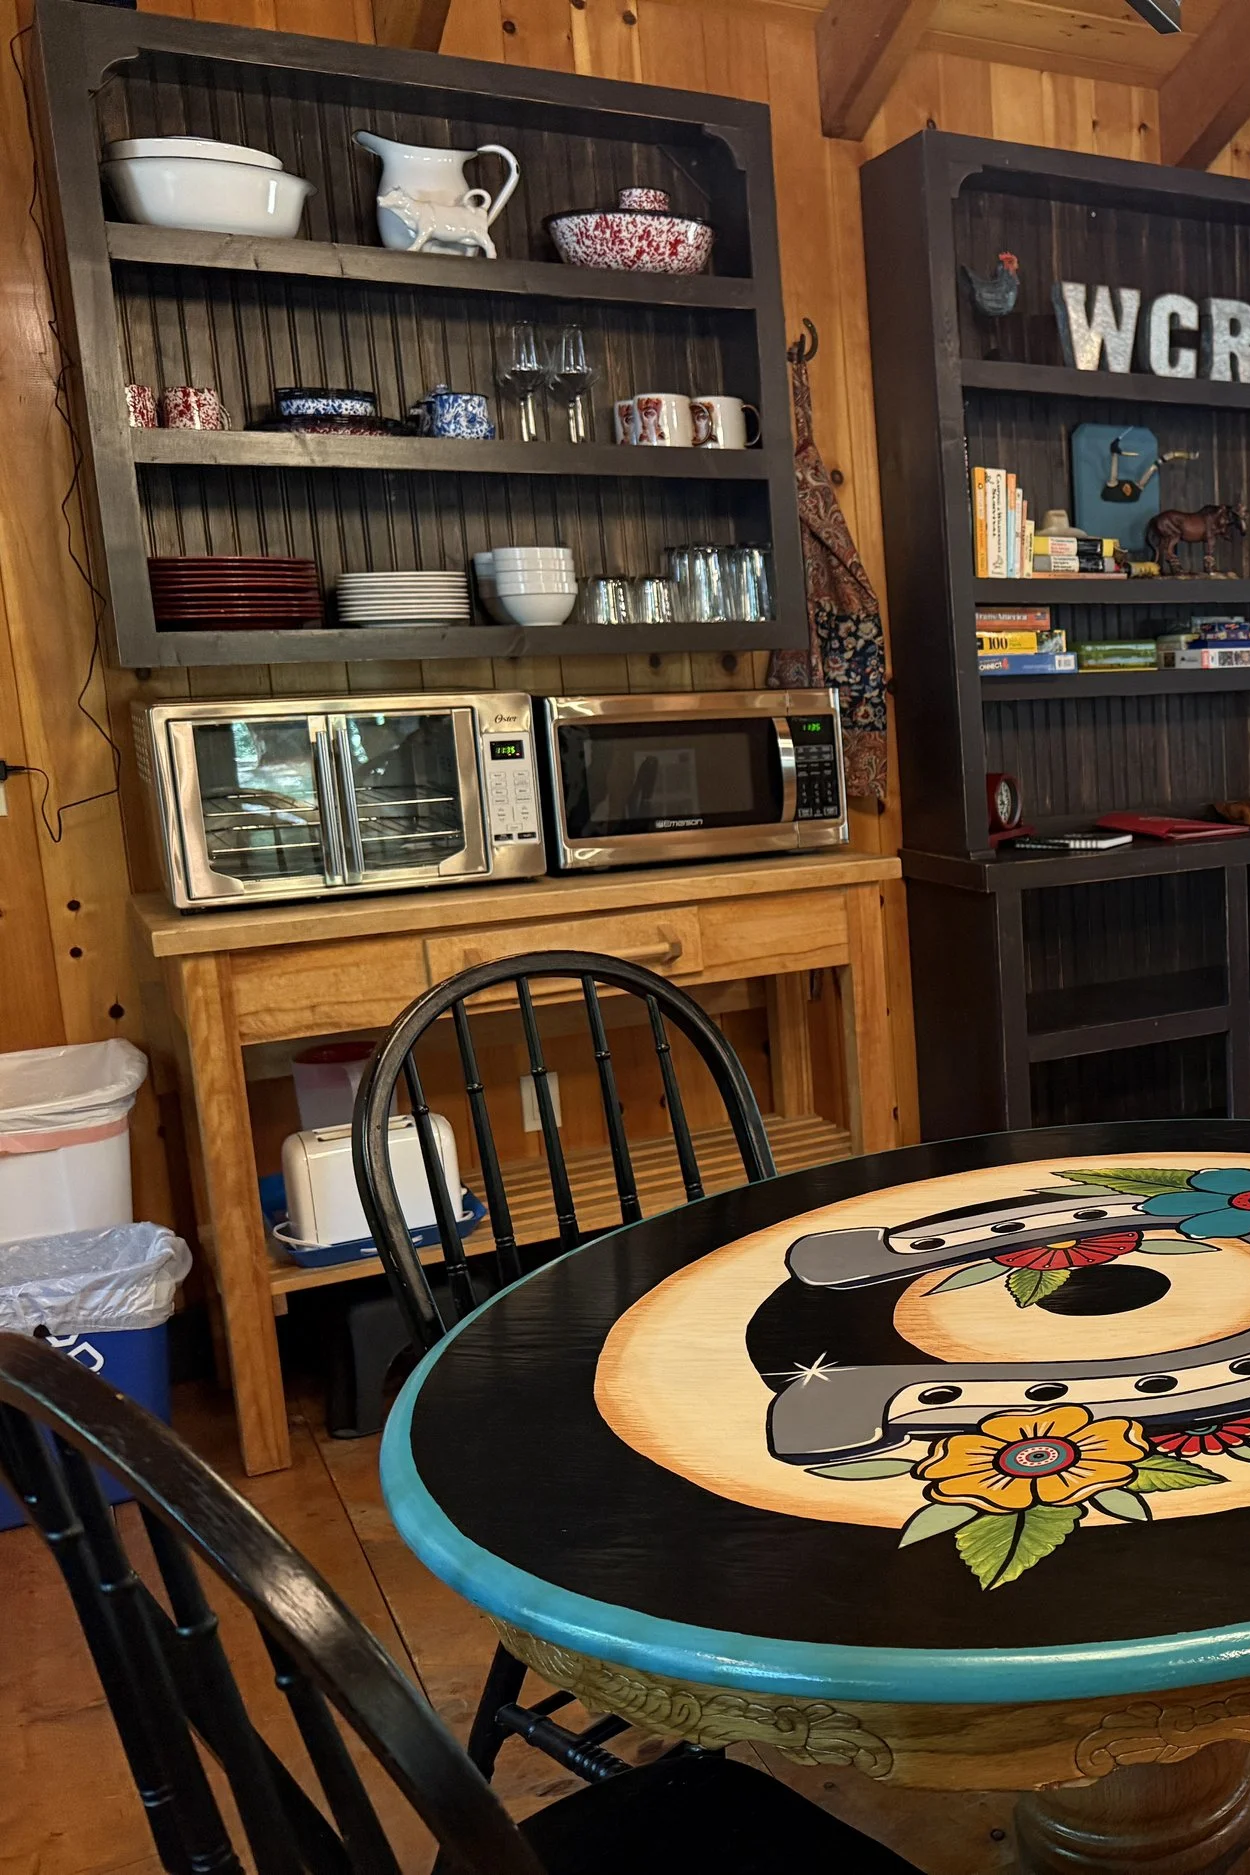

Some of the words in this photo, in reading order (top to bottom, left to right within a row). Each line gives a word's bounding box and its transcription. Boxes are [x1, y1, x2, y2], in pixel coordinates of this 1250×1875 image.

[988, 637, 1008, 650] 100
[979, 663, 1002, 671] ONNECT
[494, 713, 517, 724] Oster
[664, 818, 704, 827] Emerson
